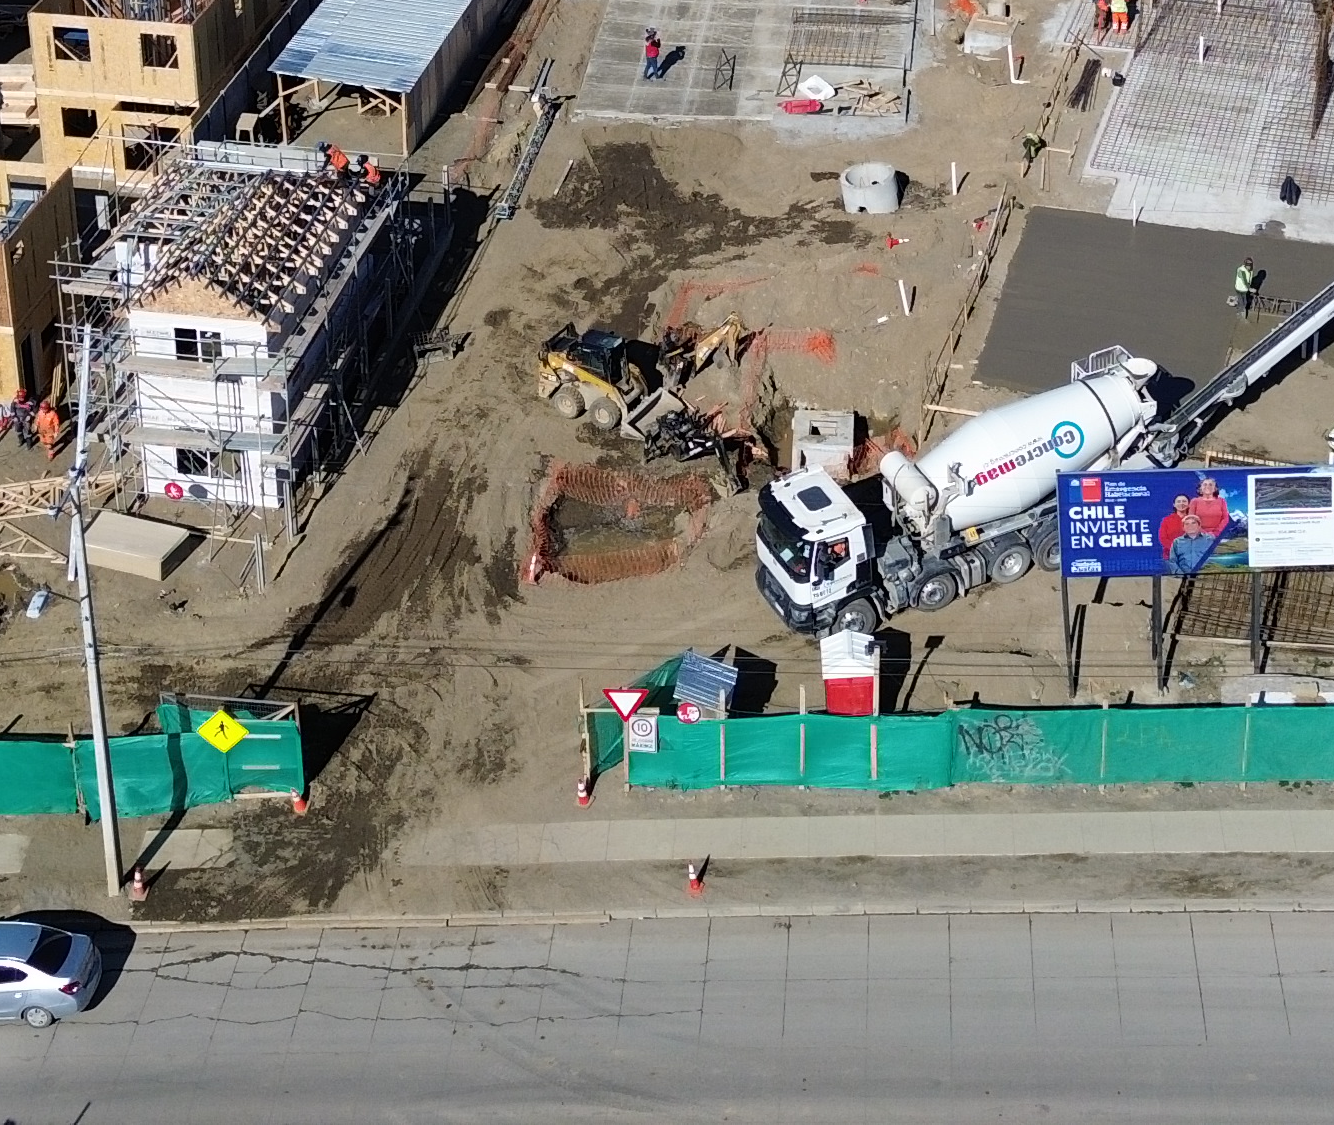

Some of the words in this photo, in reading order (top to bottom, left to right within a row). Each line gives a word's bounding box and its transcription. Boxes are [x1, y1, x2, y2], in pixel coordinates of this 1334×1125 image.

[1068, 505, 1126, 520] CHILE
[1070, 520, 1150, 534] INVIERTE
[1071, 535, 1094, 549] EN
[1098, 534, 1153, 548] CHILE
[637, 723, 648, 732] 10
